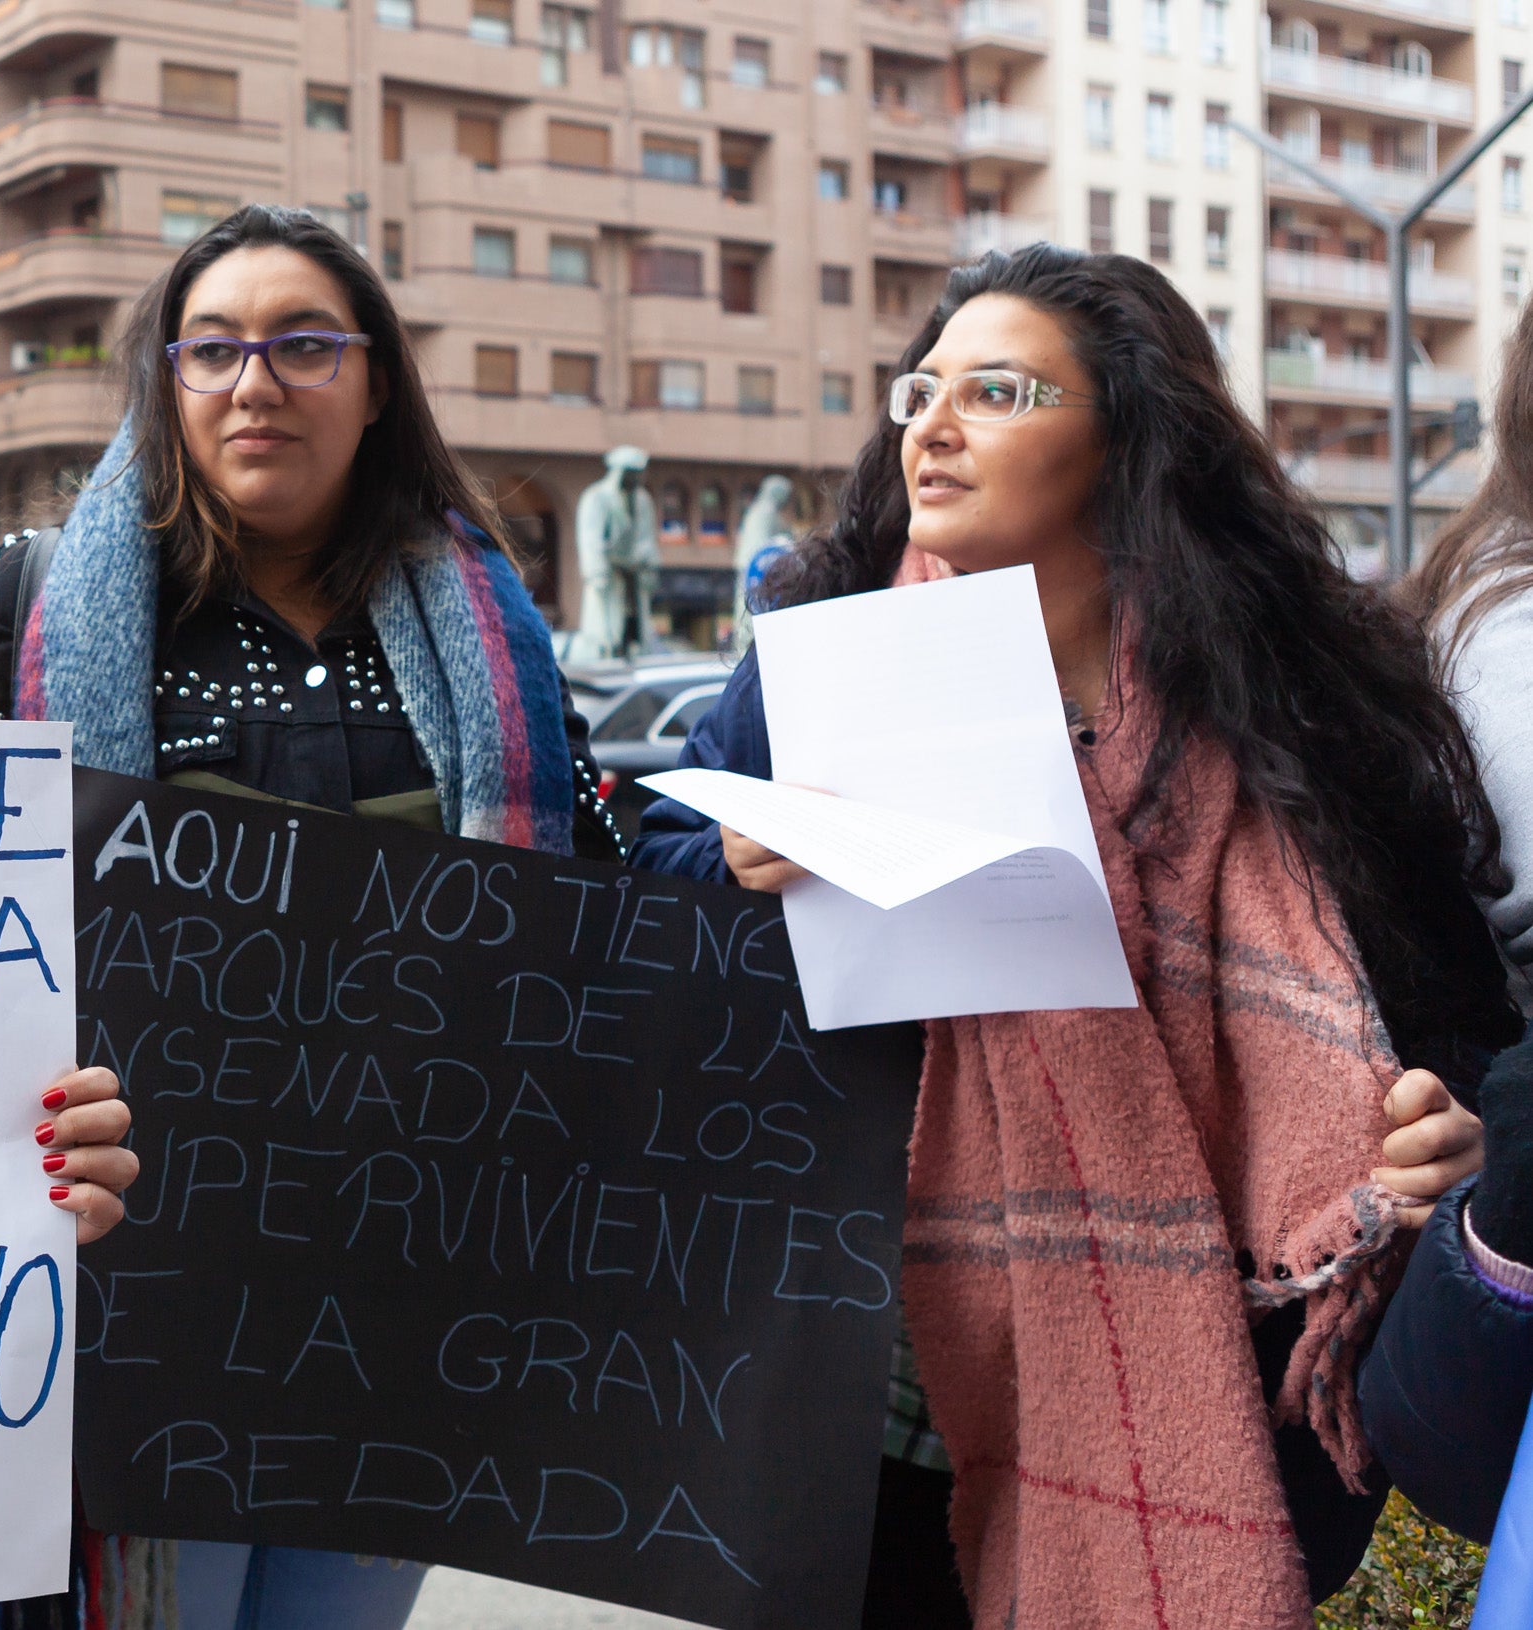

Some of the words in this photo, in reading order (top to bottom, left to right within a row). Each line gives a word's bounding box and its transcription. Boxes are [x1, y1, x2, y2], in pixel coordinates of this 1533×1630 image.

[353, 848, 517, 946] NOS
[77, 1014, 571, 1144] NSENADA
[643, 1088, 816, 1175] LOS
[495, 972, 654, 1063] DE
[700, 1006, 846, 1099] LA
[224, 1285, 372, 1391] LA
[438, 1312, 751, 1443] GRAN
[132, 1420, 761, 1588] REDADA
